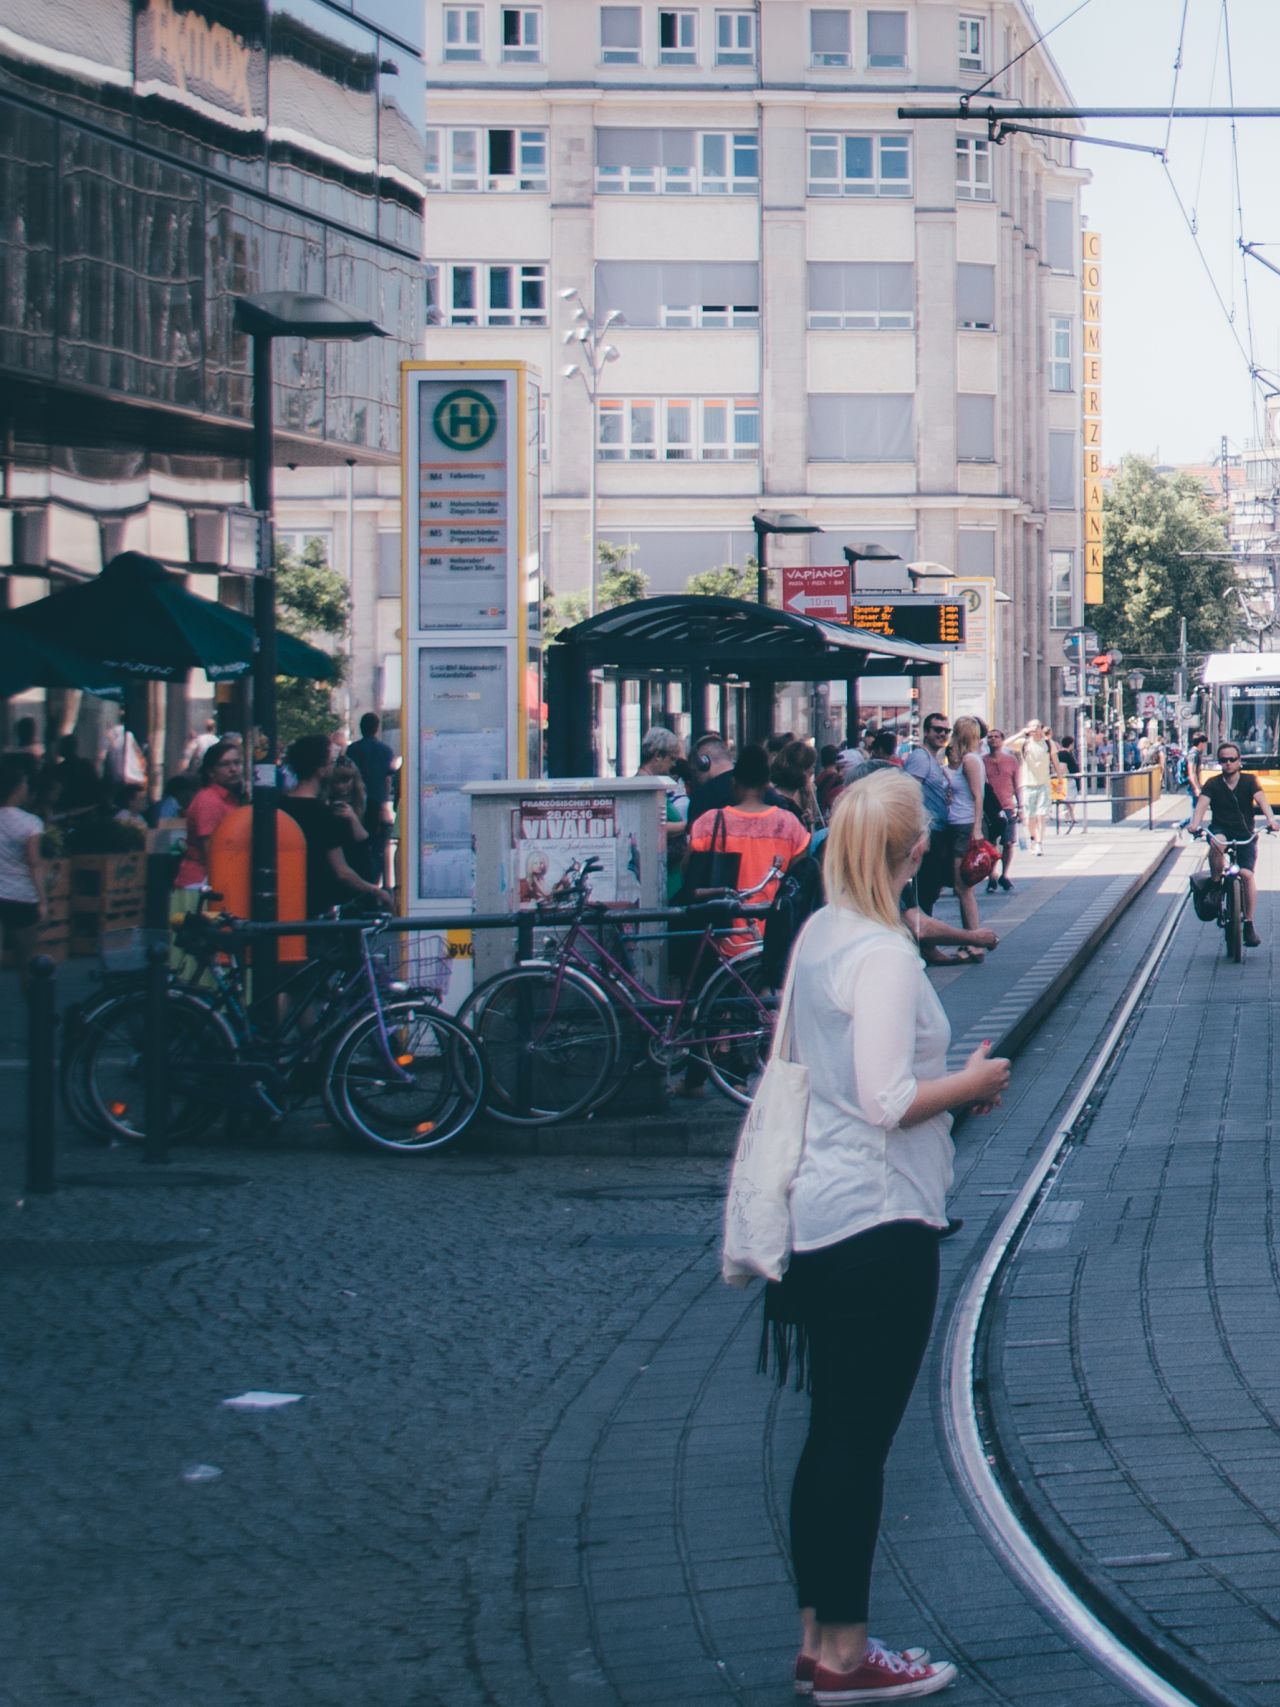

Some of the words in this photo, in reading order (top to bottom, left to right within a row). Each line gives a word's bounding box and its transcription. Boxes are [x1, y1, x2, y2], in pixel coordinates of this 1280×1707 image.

[1087, 236, 1102, 567] COMMERZBANK
[449, 403, 481, 438] H
[522, 799, 591, 808] FRANZÖSISCHER
[547, 809, 593, 819] 28.05.16
[523, 818, 614, 839] VIVALDI
